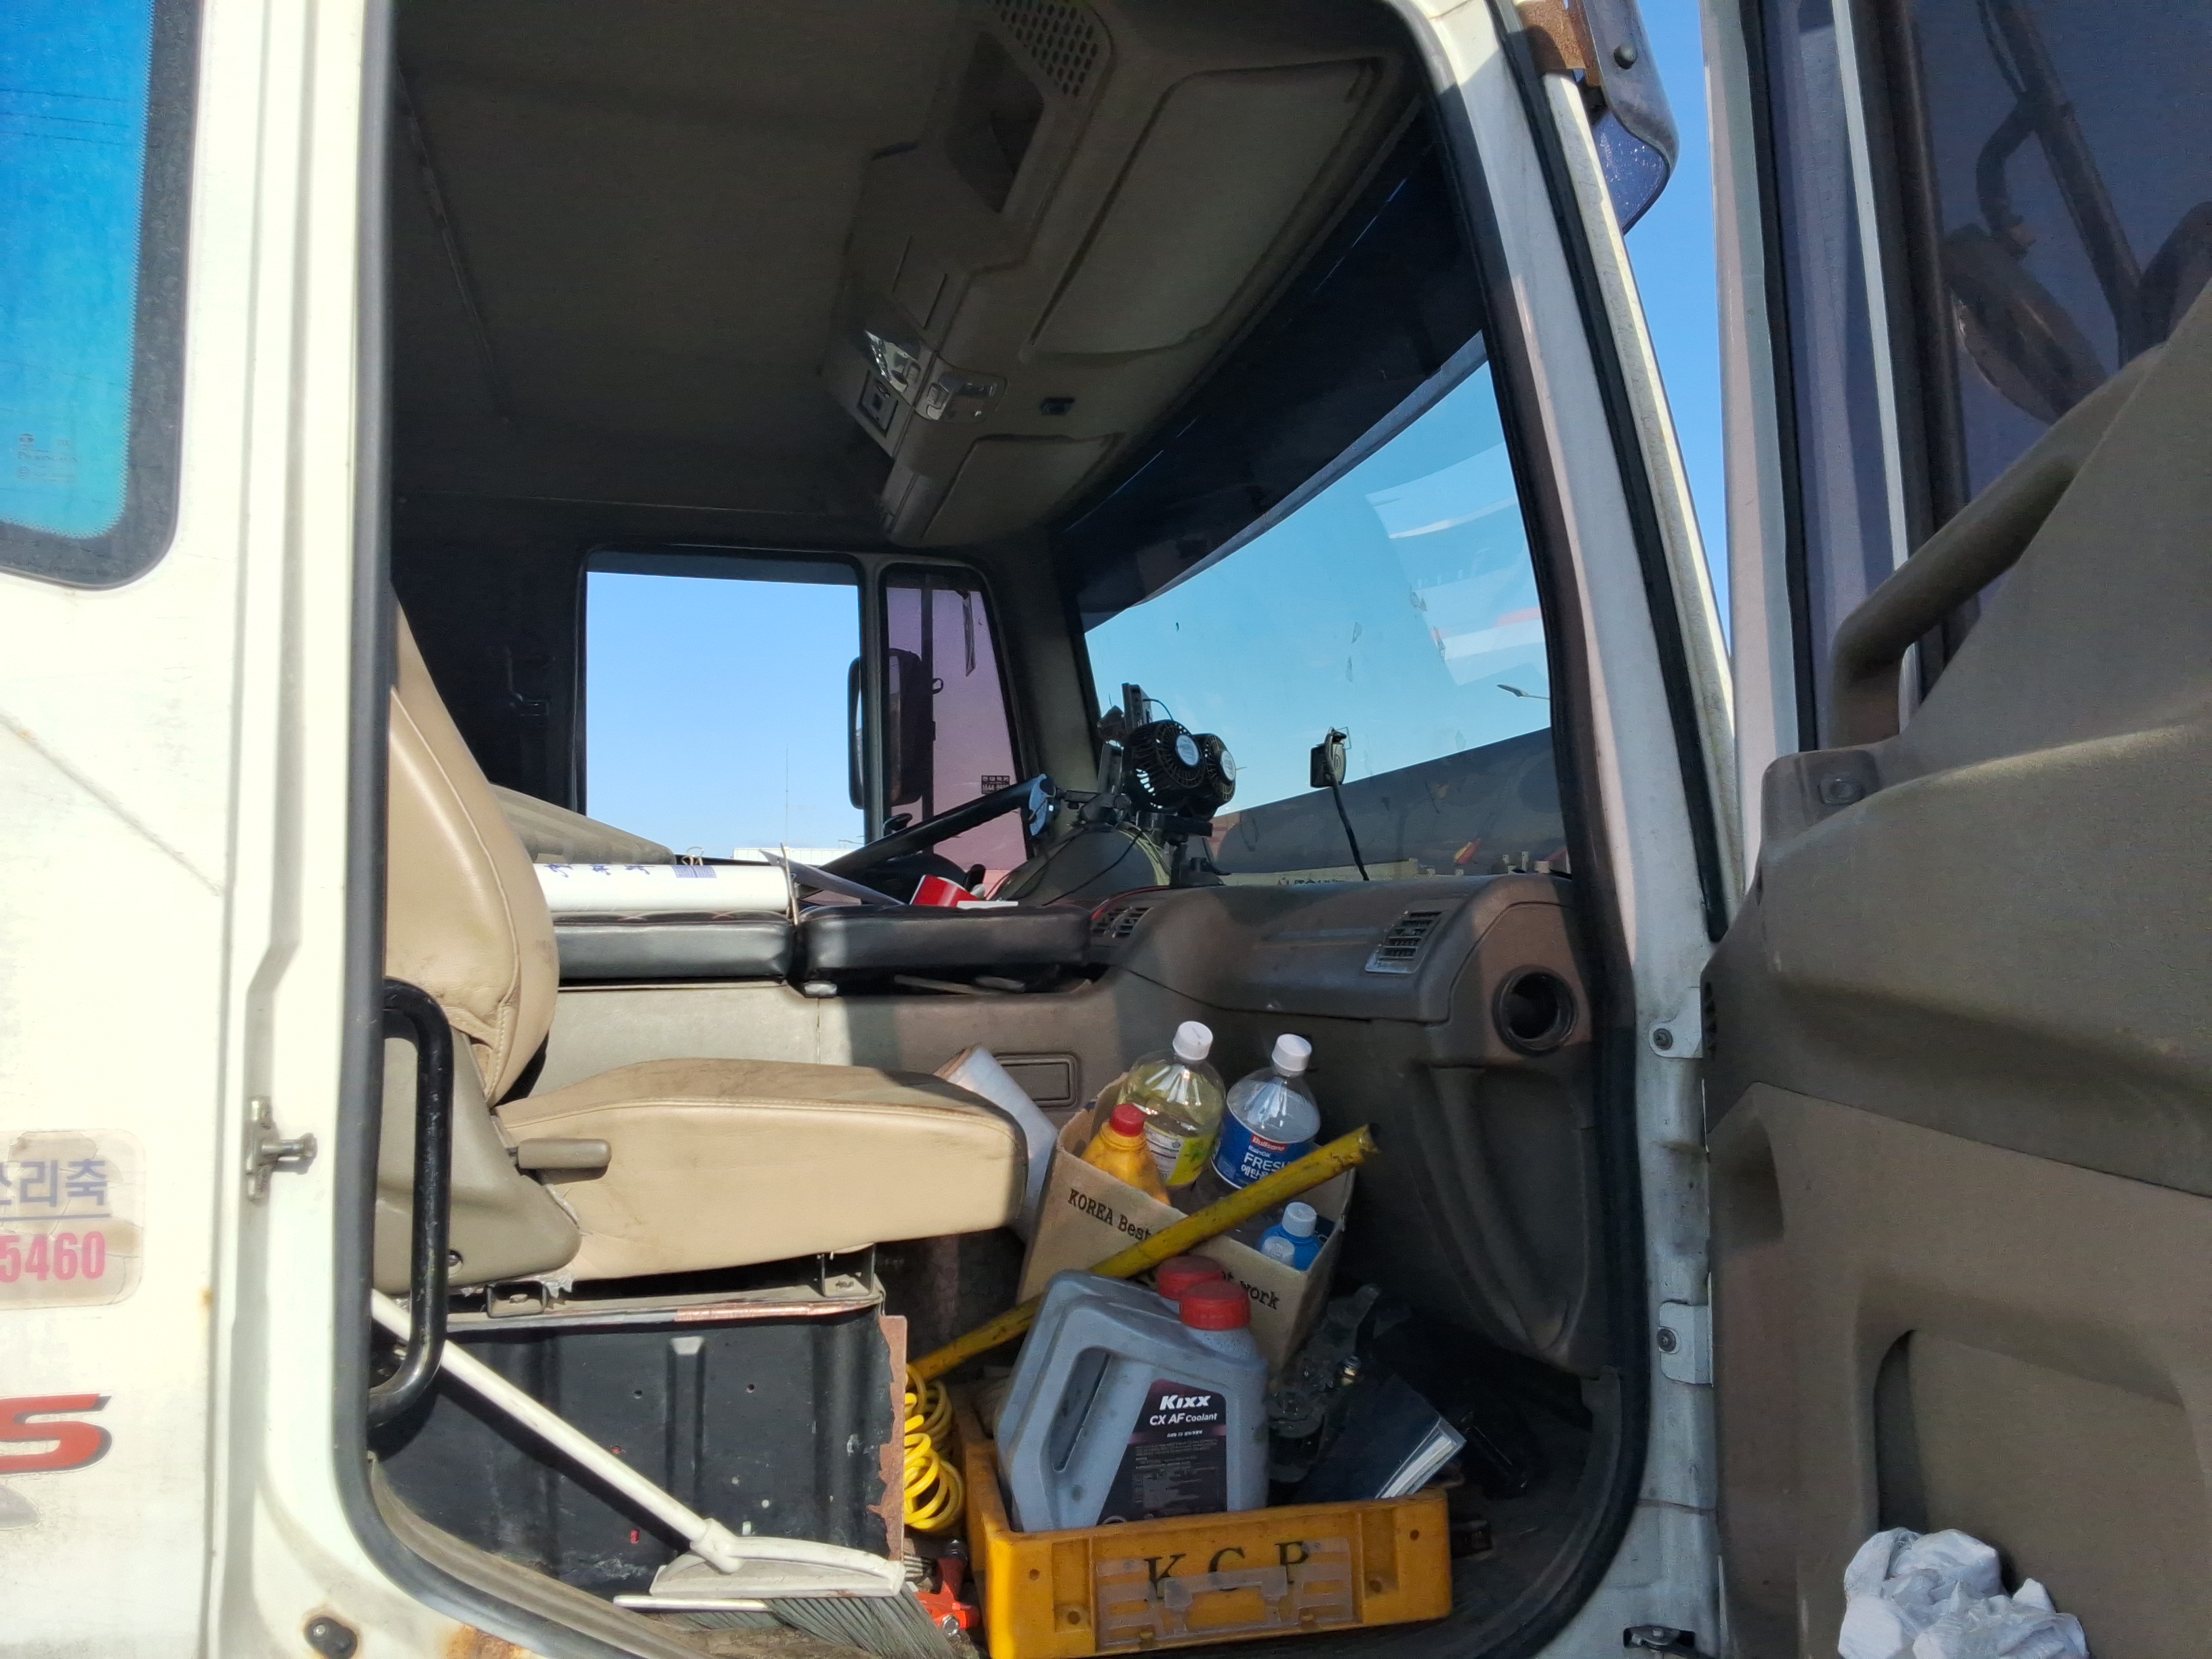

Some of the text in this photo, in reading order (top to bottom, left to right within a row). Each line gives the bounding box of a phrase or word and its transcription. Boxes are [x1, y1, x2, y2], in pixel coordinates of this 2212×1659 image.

[1067, 1188, 1113, 1227] KOREA
[1117, 1214, 1151, 1241] Best
[0, 1231, 106, 1283] 5460
[1149, 1412, 1218, 1426] CX AF Coolant
[1160, 1395, 1211, 1411] Kixx
